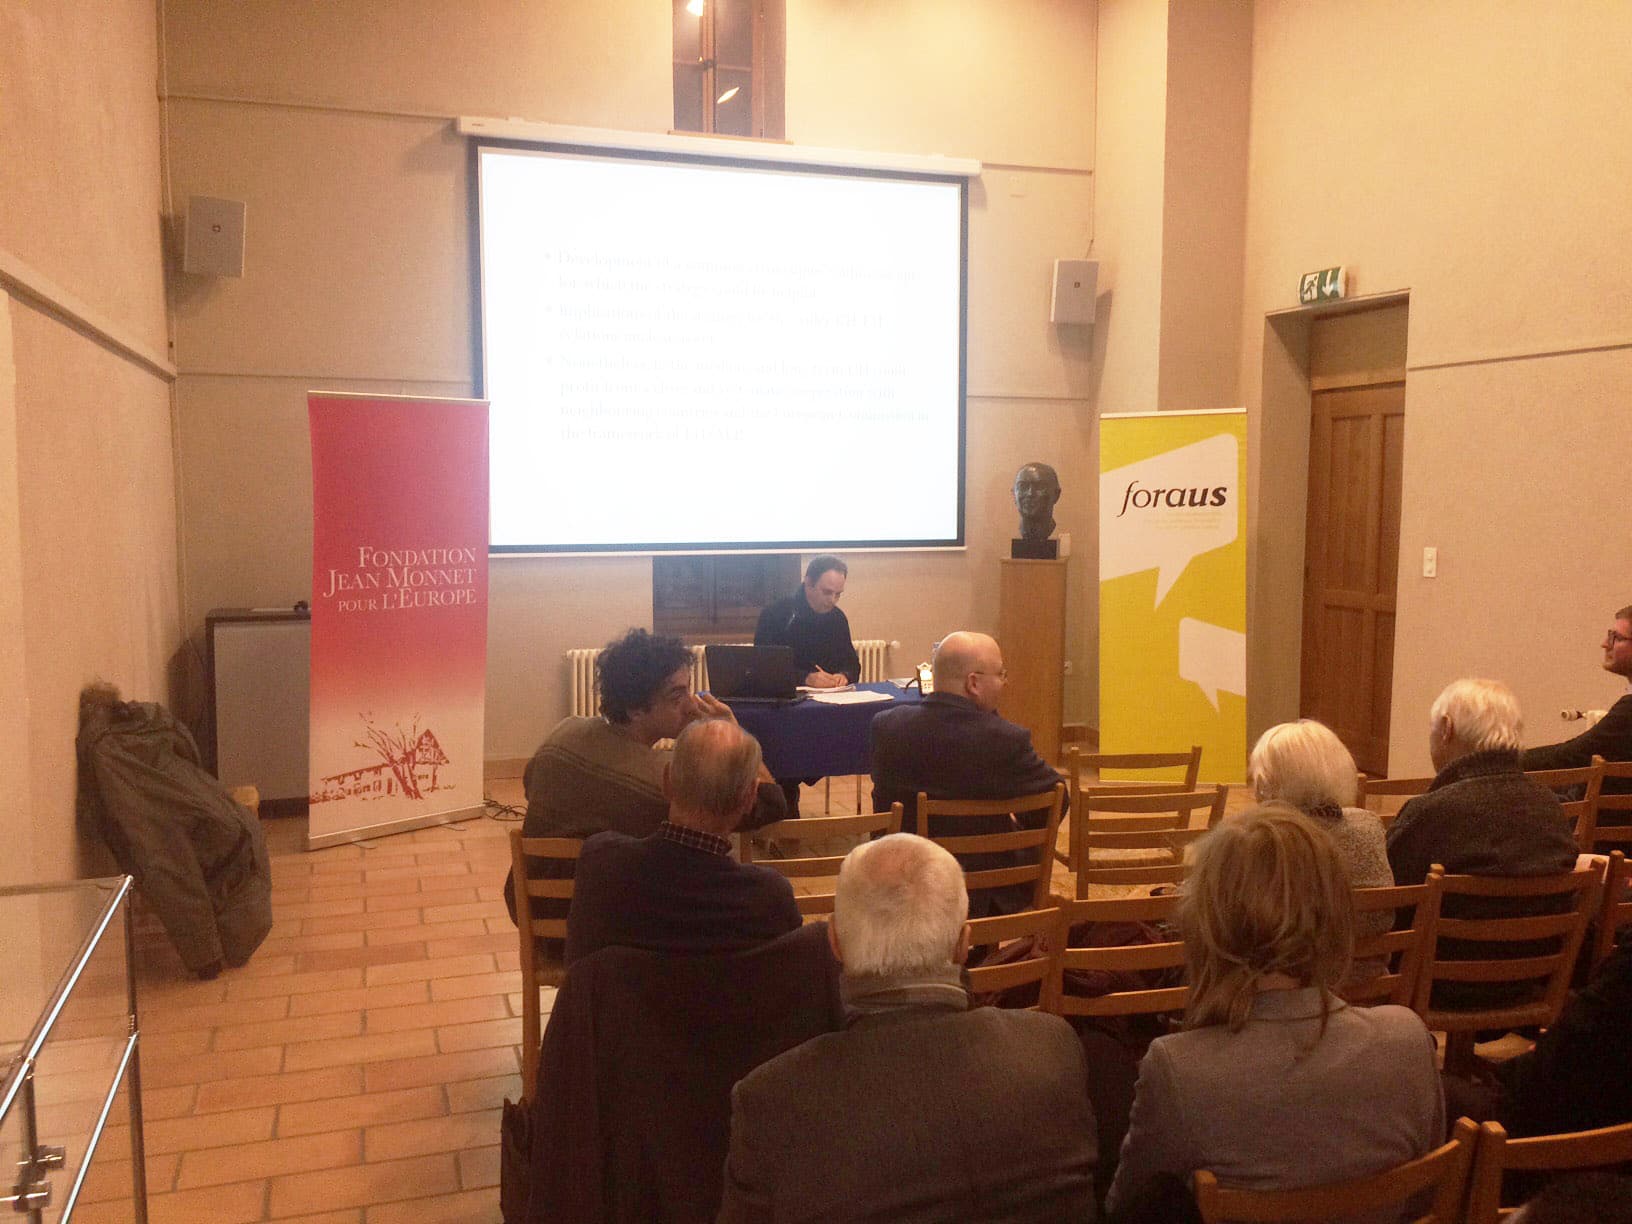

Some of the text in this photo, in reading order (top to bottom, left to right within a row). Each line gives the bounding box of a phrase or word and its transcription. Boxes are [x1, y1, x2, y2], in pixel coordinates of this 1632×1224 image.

[1116, 480, 1228, 518] foraus
[358, 546, 477, 568] FONDATION
[323, 566, 477, 598] JEAN MONNET
[338, 588, 477, 612] POUR L'EUROPE
